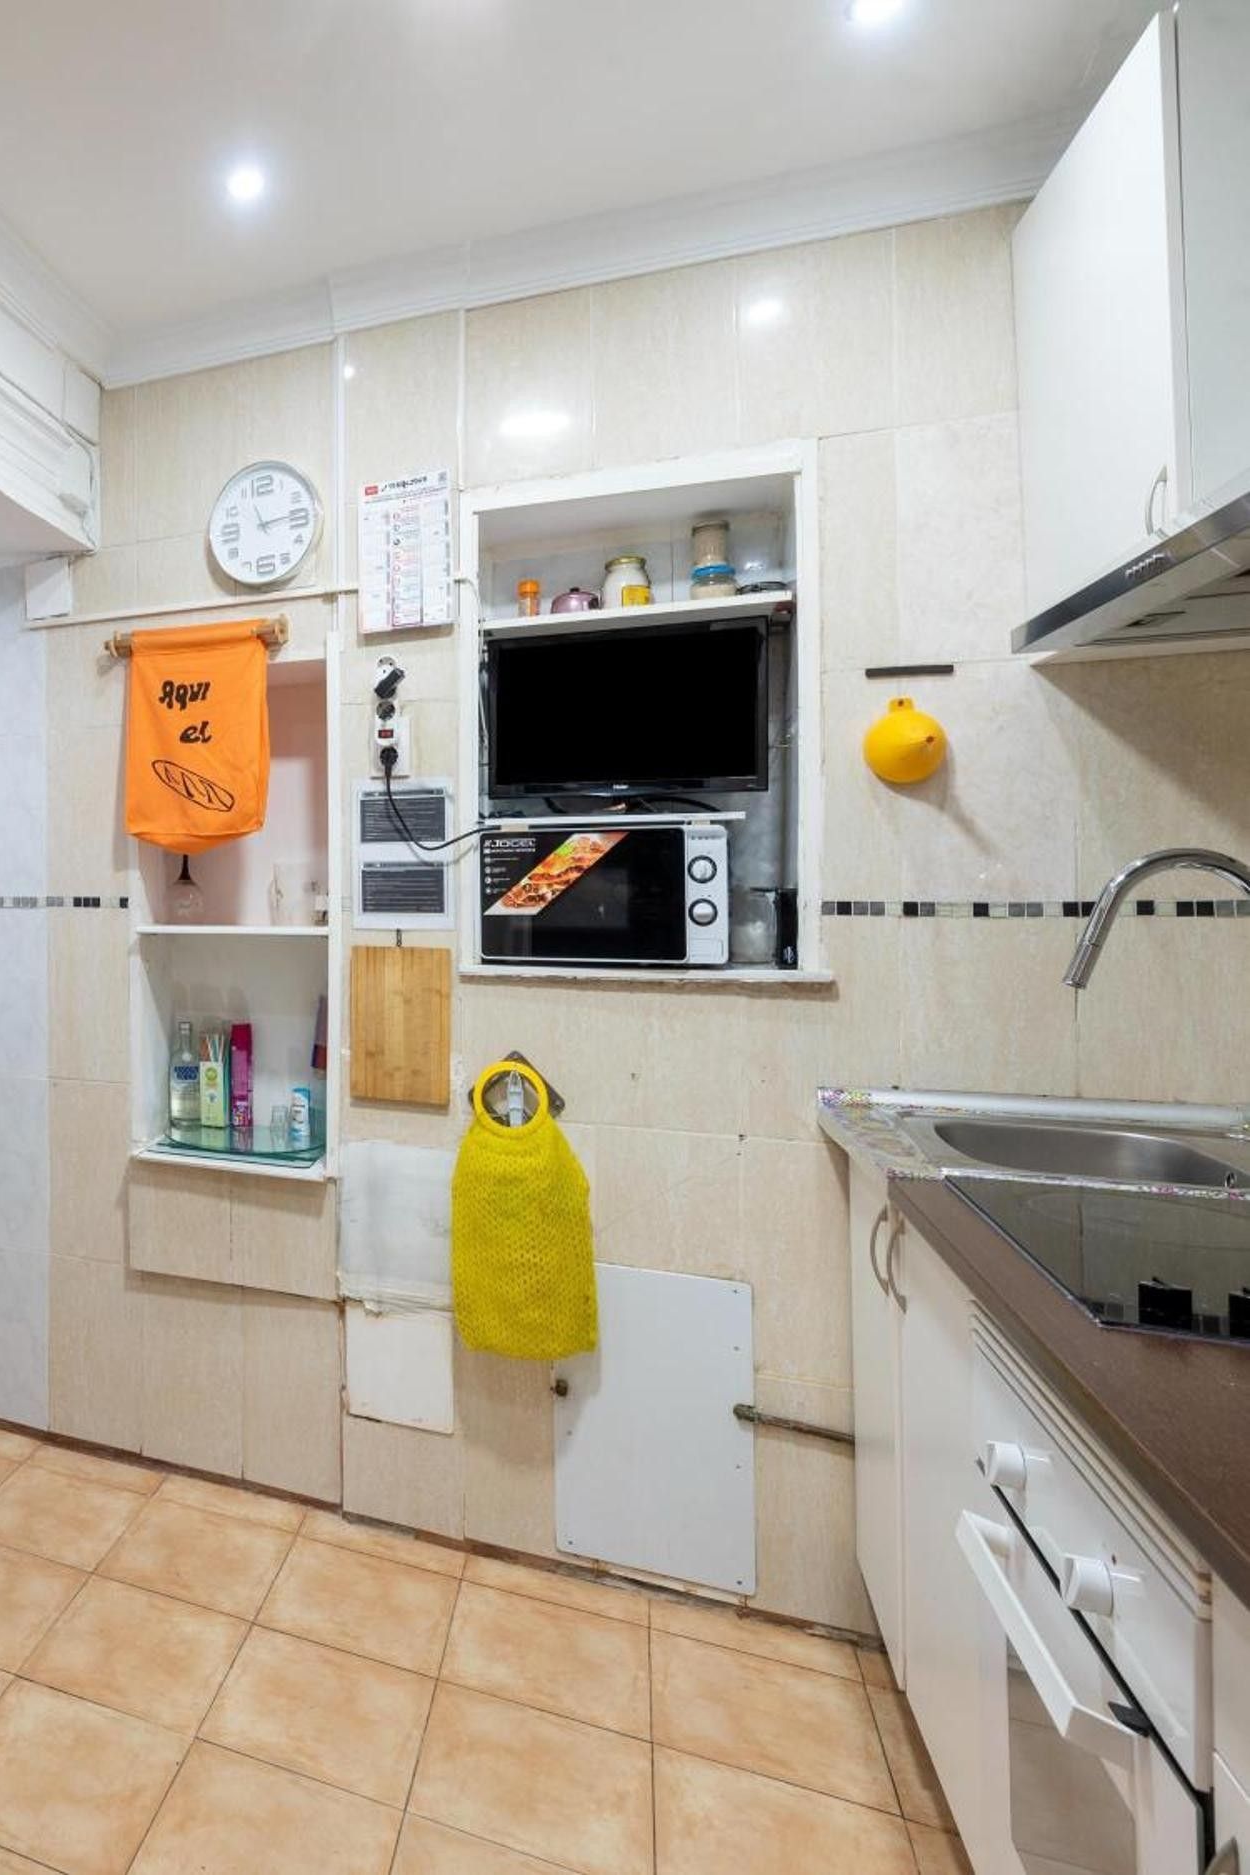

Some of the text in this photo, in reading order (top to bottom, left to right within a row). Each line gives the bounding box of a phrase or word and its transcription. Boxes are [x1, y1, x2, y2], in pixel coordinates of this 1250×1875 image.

[251, 474, 273, 499] 12
[289, 507, 309, 530] 3
[221, 523, 240, 545] 9
[294, 533, 303, 544] 4
[256, 554, 275, 575] 6
